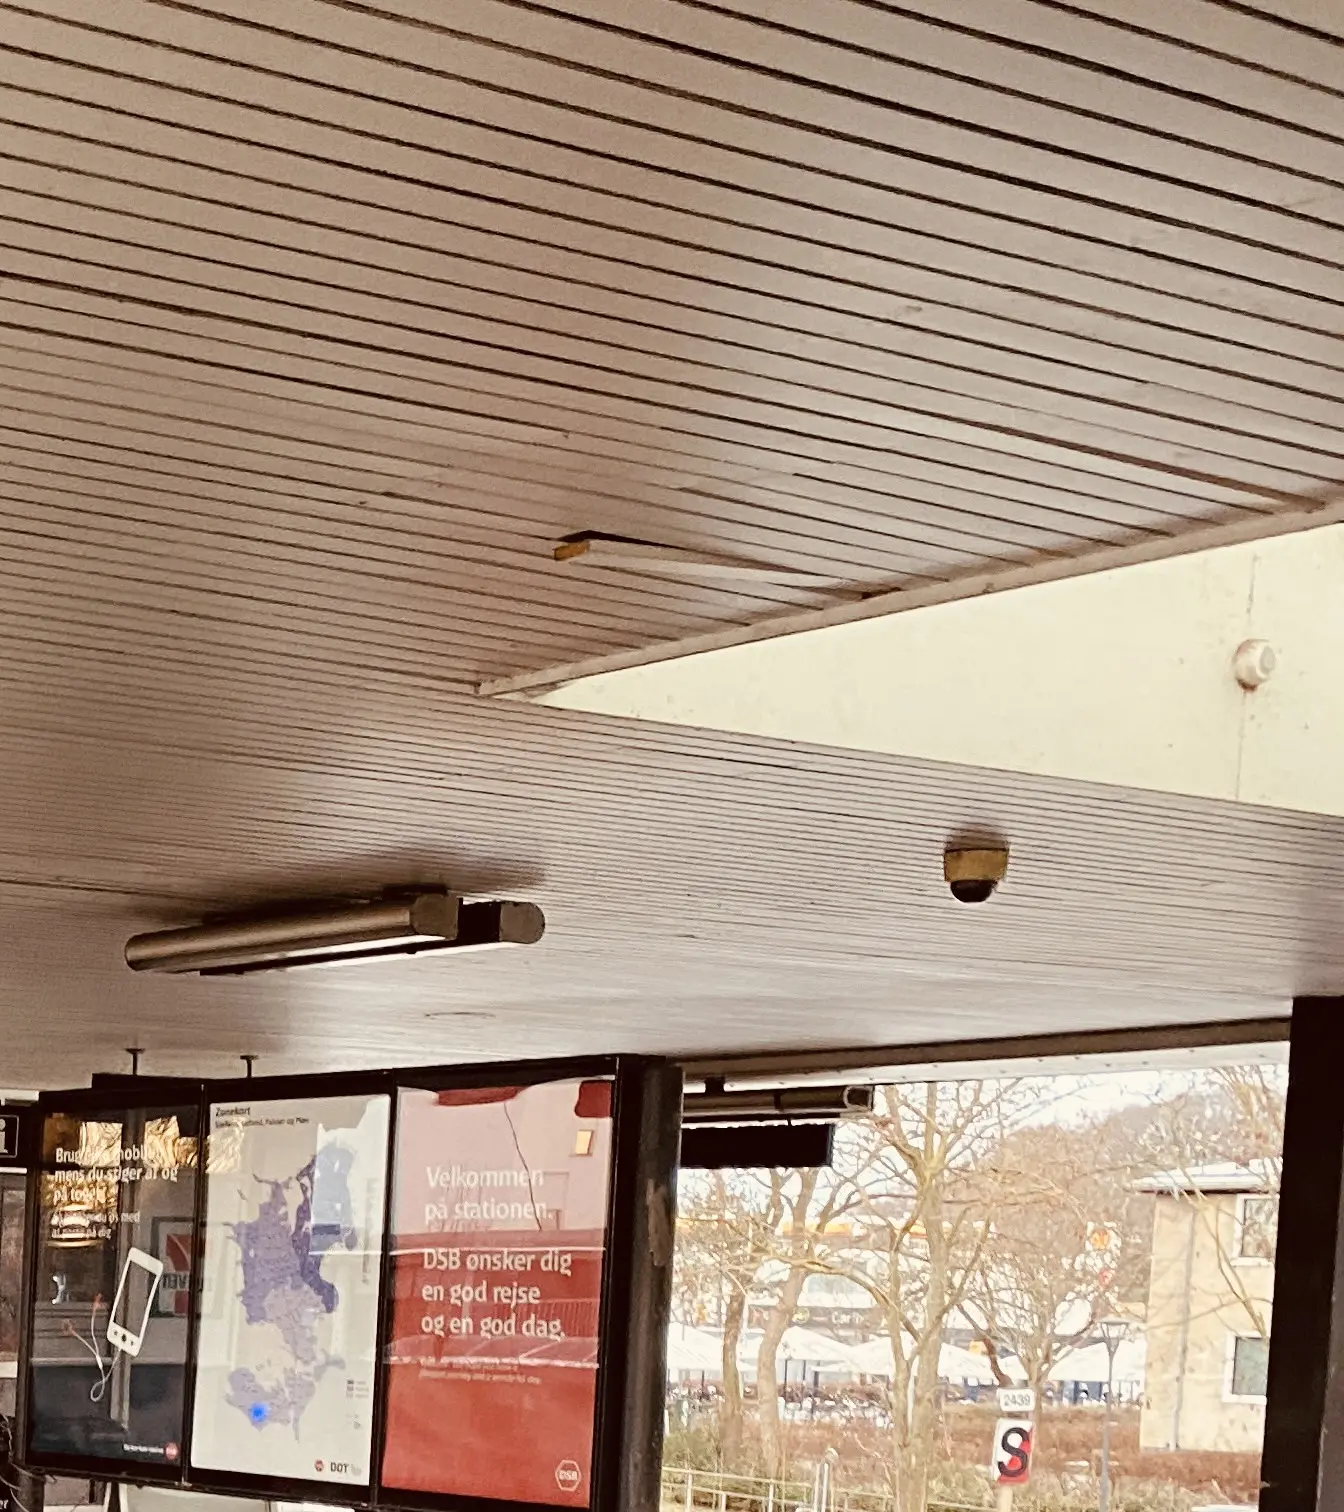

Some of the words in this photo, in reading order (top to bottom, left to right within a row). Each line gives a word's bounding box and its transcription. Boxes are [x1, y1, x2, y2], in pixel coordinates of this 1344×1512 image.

[161, 1167, 178, 1183] og
[426, 1166, 545, 1188] Velkommen
[424, 1203, 448, 1226] på
[454, 1199, 554, 1220] stationen.
[423, 1249, 461, 1270] DSB
[465, 1250, 538, 1271] ønsker
[540, 1248, 572, 1277] dig
[422, 1284, 444, 1302] en
[450, 1280, 487, 1307] god
[493, 1282, 541, 1309] rejse
[421, 1314, 445, 1338] og
[449, 1315, 474, 1335] en
[480, 1314, 516, 1340] god
[521, 1313, 566, 1343] dag.
[1004, 1393, 1031, 1407] 2439
[997, 1426, 1030, 1478] S
[330, 1461, 349, 1473] DOT
